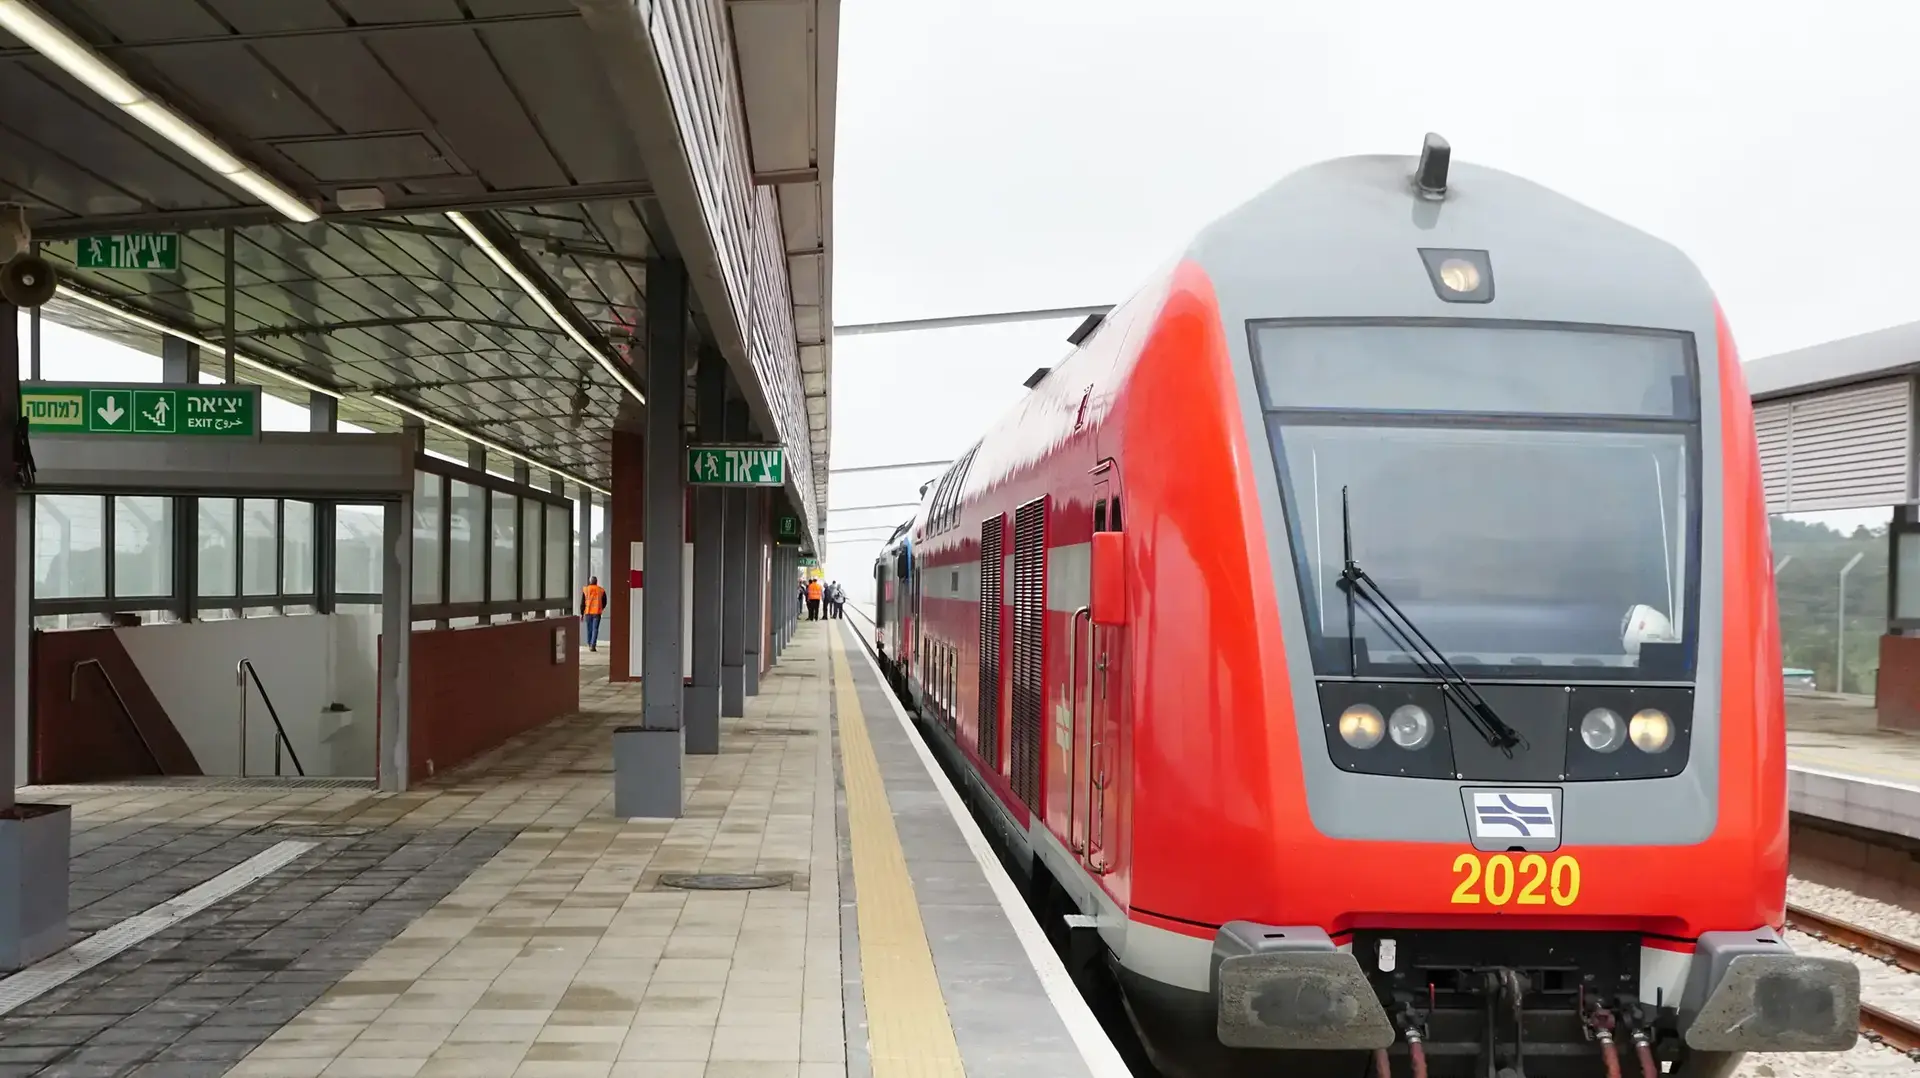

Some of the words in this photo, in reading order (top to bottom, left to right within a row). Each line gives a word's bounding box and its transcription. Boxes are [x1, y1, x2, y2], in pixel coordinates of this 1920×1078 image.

[111, 235, 167, 268] יציאה
[26, 400, 79, 418] למחסה
[187, 396, 243, 413] יציאה
[187, 418, 212, 428] EXIT
[214, 417, 243, 430] خروج
[725, 451, 778, 482] יציאה
[1451, 853, 1581, 907] 2020
